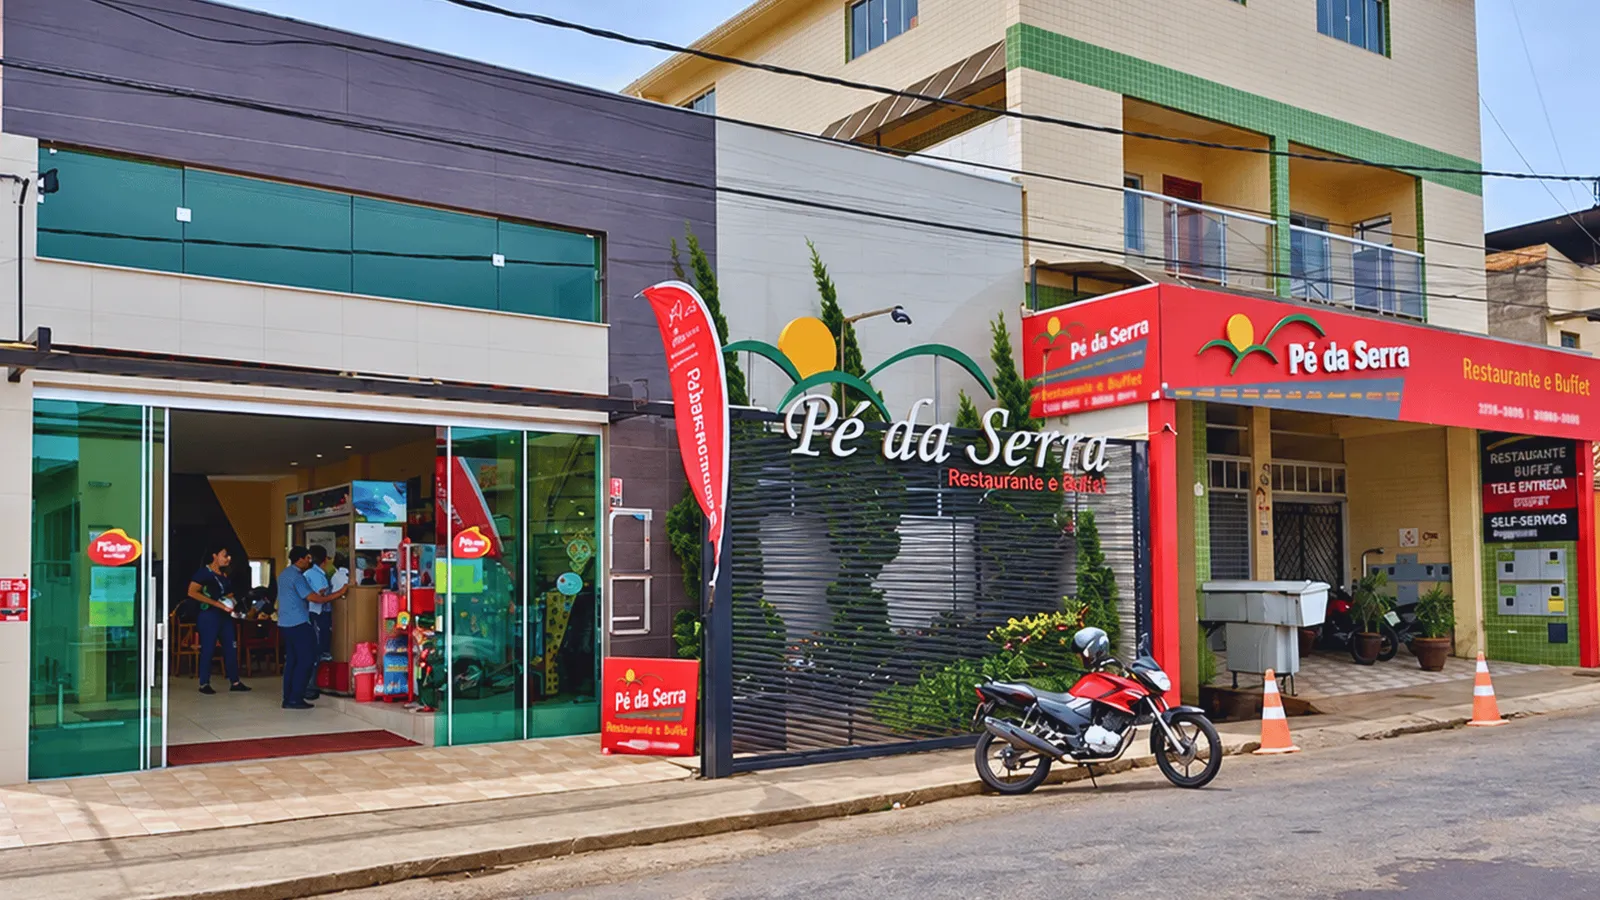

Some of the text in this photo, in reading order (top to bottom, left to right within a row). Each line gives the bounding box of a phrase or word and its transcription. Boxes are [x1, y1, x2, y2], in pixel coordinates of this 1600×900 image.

[1071, 338, 1087, 360] Pé
[1091, 333, 1108, 352] da
[1110, 320, 1148, 346] Serra
[1289, 339, 1410, 374] Pé da Serra
[1463, 357, 1591, 396] Restaurante e Buffet
[784, 394, 1110, 473] Pé da Serra
[949, 468, 1044, 490] Restaurante
[1048, 478, 1059, 491] e
[1491, 478, 1567, 494] TELE ENTREGA
[615, 687, 686, 711] Pé da Serra
